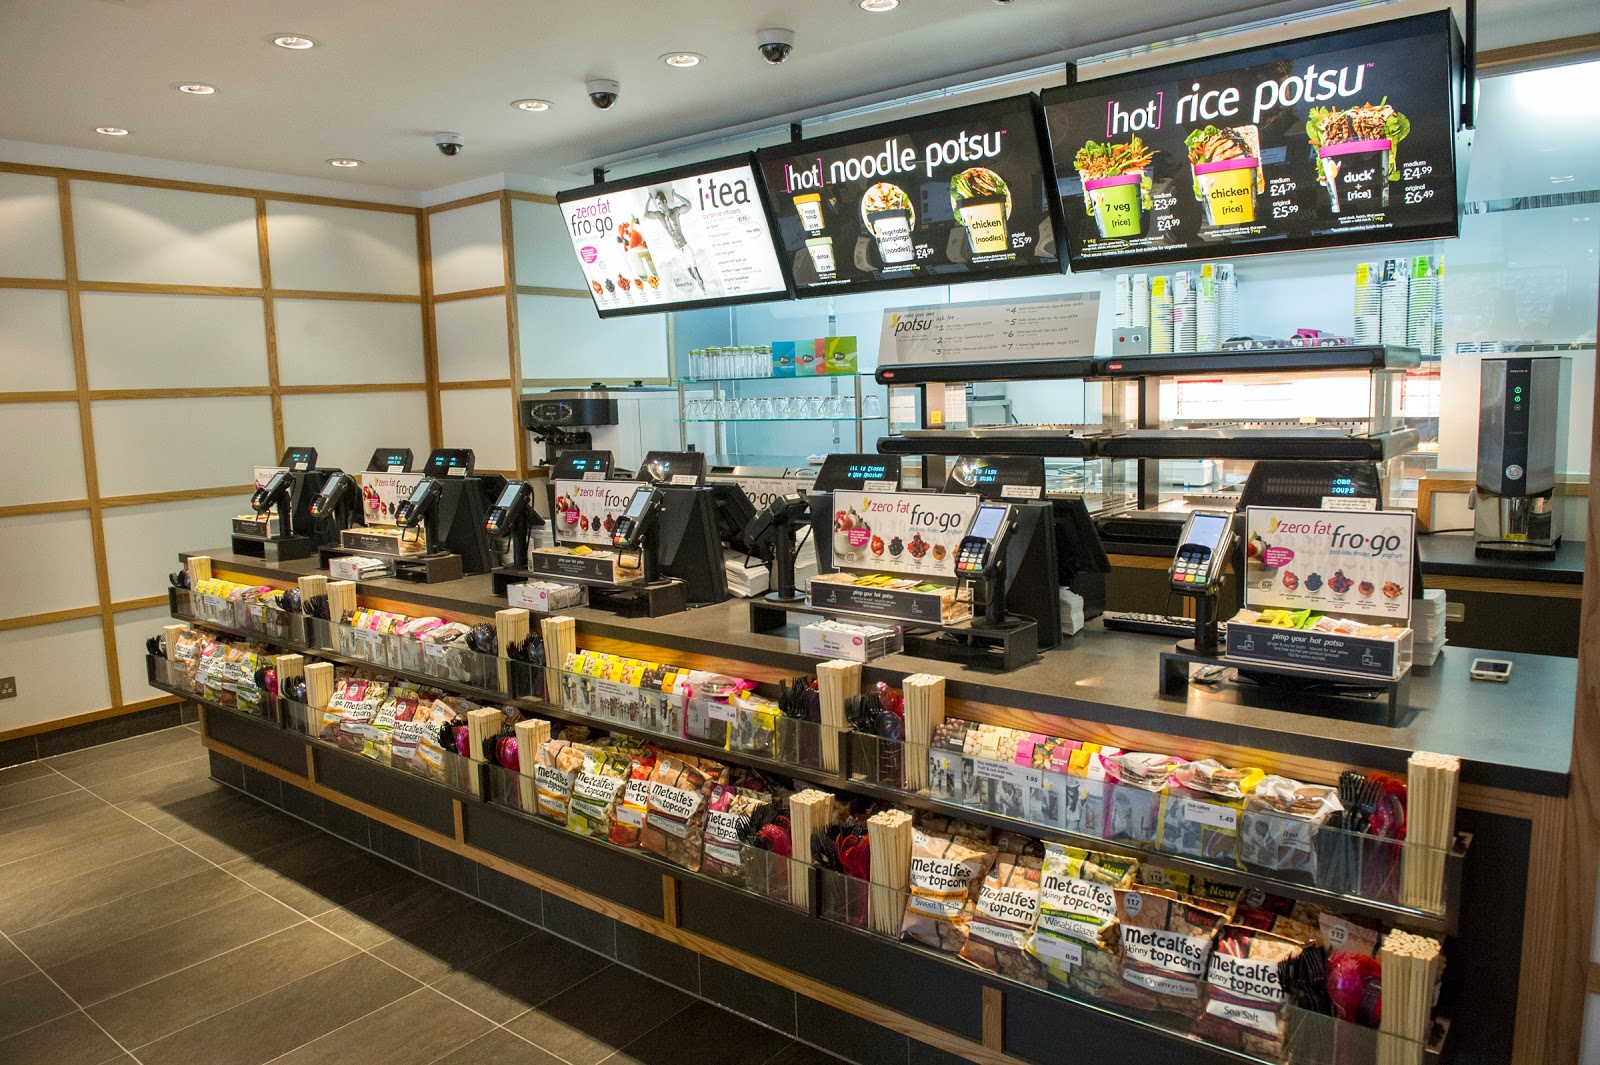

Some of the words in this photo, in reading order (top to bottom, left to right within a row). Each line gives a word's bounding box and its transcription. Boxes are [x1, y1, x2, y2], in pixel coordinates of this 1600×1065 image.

[1107, 91, 1163, 138] [hot]
[1175, 82, 1240, 125] rice
[1252, 64, 1365, 124] potsu
[785, 158, 823, 193] [hot]
[830, 138, 916, 184] noodle
[926, 130, 1001, 178] potsu
[1403, 160, 1427, 168] medium
[1403, 166, 1432, 181] £4.99
[1211, 187, 1249, 199] chicken
[1270, 182, 1296, 197] £4.79
[1405, 184, 1426, 192] original
[1347, 189, 1372, 201] [rice]
[1404, 190, 1434, 204] £6.49
[575, 204, 597, 220] zero
[597, 197, 611, 215] fat
[1105, 204, 1110, 212] 7
[1113, 203, 1130, 212] veg
[1154, 197, 1177, 211] £3.69
[1272, 199, 1291, 207] original
[1222, 205, 1243, 215] [rice]
[1272, 205, 1299, 218] £5.99
[972, 219, 1002, 229] chicken
[1112, 218, 1131, 227] [rice]
[1157, 218, 1180, 232] £4.99
[882, 227, 907, 236] vegetable
[882, 234, 910, 242] dumplings
[1012, 236, 1032, 248] £5.99
[916, 248, 934, 259] £4.99
[894, 317, 933, 336] potsu
[378, 479, 389, 487] zero
[579, 488, 594, 497] zero
[595, 486, 605, 497] fat
[871, 502, 893, 513] zero
[895, 499, 911, 514] fat
[1280, 522, 1311, 534] zero
[1313, 520, 1333, 535] fat
[1271, 633, 1290, 641] pimp
[1290, 634, 1307, 643] your
[1309, 635, 1322, 644] hot
[1323, 639, 1345, 647] potsu
[585, 784, 612, 800] topcorn
[662, 798, 690, 816] topcorn
[1197, 803, 1211, 811] cakes
[1219, 814, 1234, 824] 1.49
[928, 874, 967, 889] topcorn
[1027, 870, 1040, 880] Ne
[1209, 886, 1236, 899] New
[915, 898, 936, 910] Sweet
[1041, 890, 1062, 902] skinny
[1063, 894, 1110, 918] topcorn
[1126, 898, 1140, 906] 117
[990, 902, 1033, 922] topcorn
[1044, 916, 1072, 932] Wasabi
[1073, 924, 1095, 938] Glaze
[1332, 930, 1345, 940] 115
[1065, 953, 1079, 962] 0.99
[1125, 944, 1148, 956] skinny
[1150, 946, 1201, 971] topcorn
[1208, 972, 1230, 984] skinny
[1230, 976, 1286, 999] topcorn
[1224, 1006, 1240, 1018] Sea
[1242, 1010, 1260, 1023] Salt
